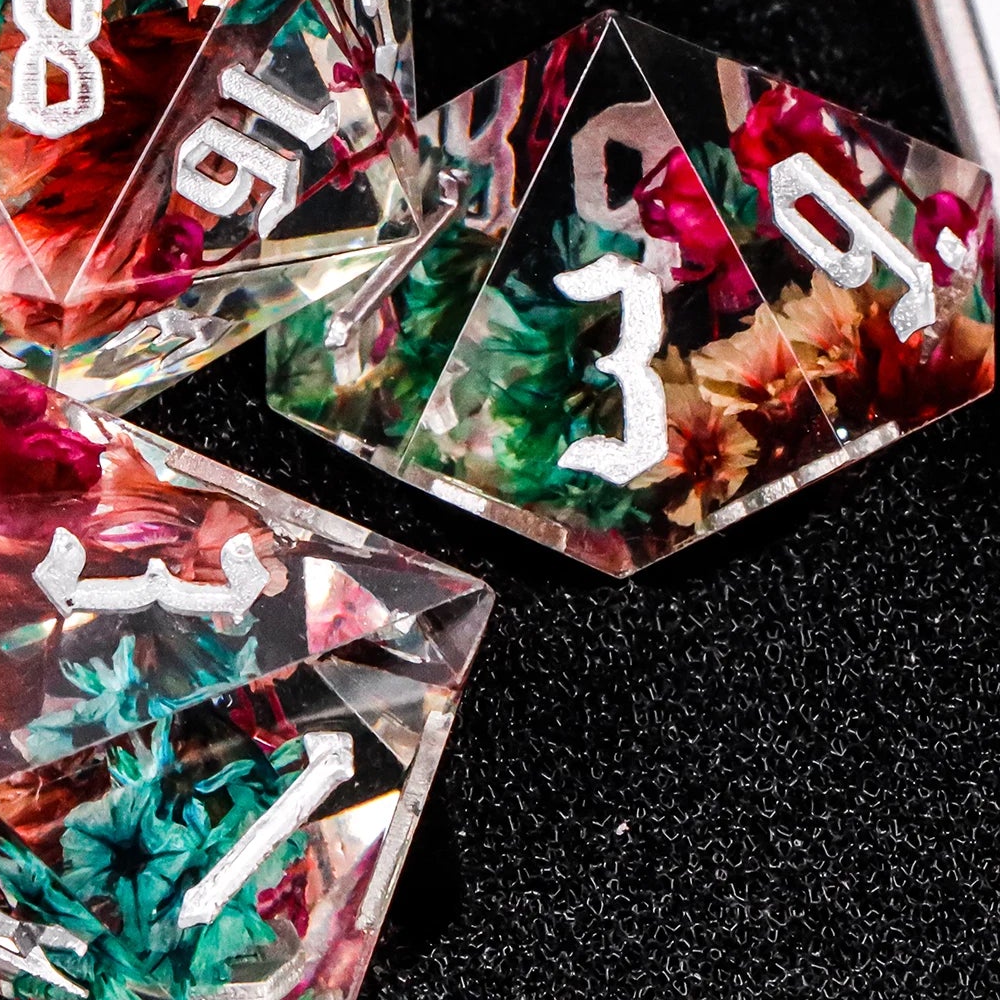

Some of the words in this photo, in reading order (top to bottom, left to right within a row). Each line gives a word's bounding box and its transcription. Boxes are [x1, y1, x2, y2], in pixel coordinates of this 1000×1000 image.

[175, 63, 340, 239] 16
[553, 253, 669, 486] 3
[31, 526, 271, 625] 3
